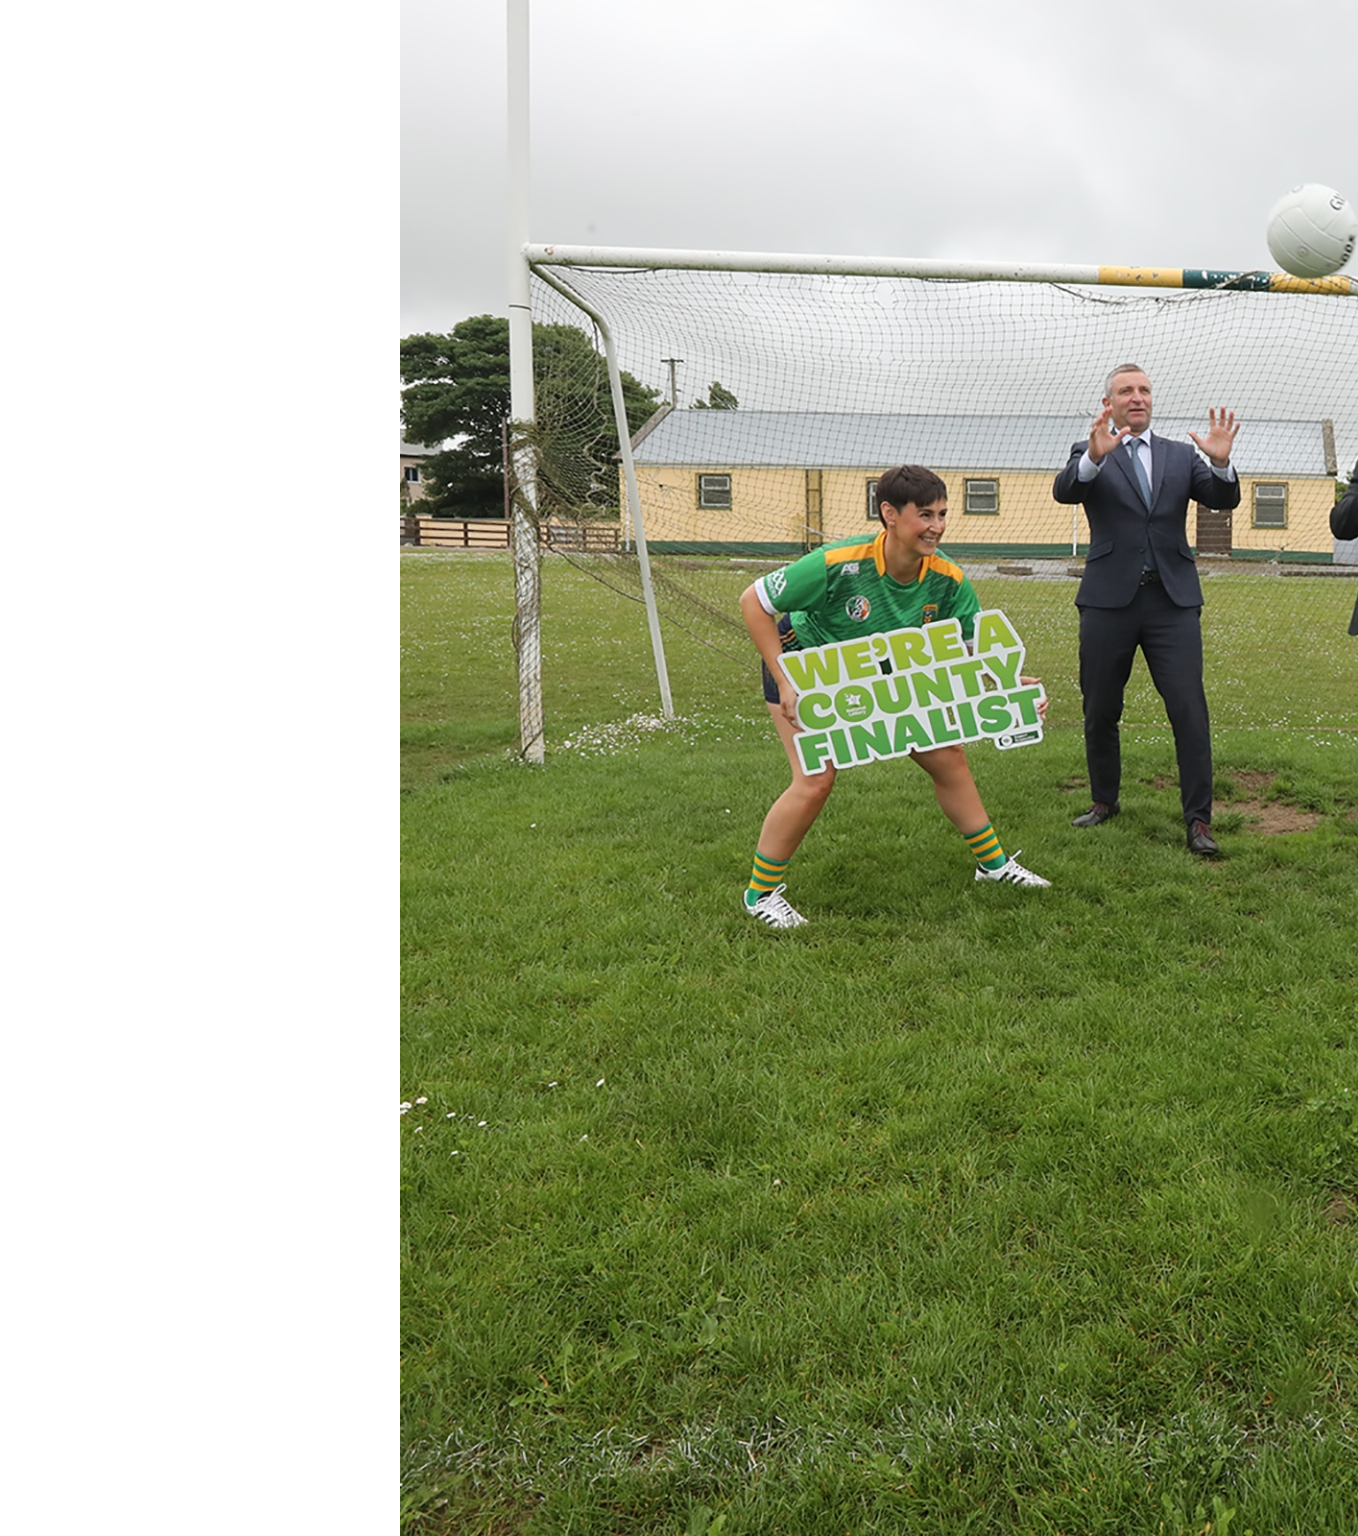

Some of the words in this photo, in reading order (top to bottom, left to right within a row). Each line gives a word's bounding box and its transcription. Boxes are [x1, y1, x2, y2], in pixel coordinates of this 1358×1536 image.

[978, 614, 1018, 655] A
[798, 688, 1041, 771] FINALIST
[799, 651, 1022, 730] COUNTY
